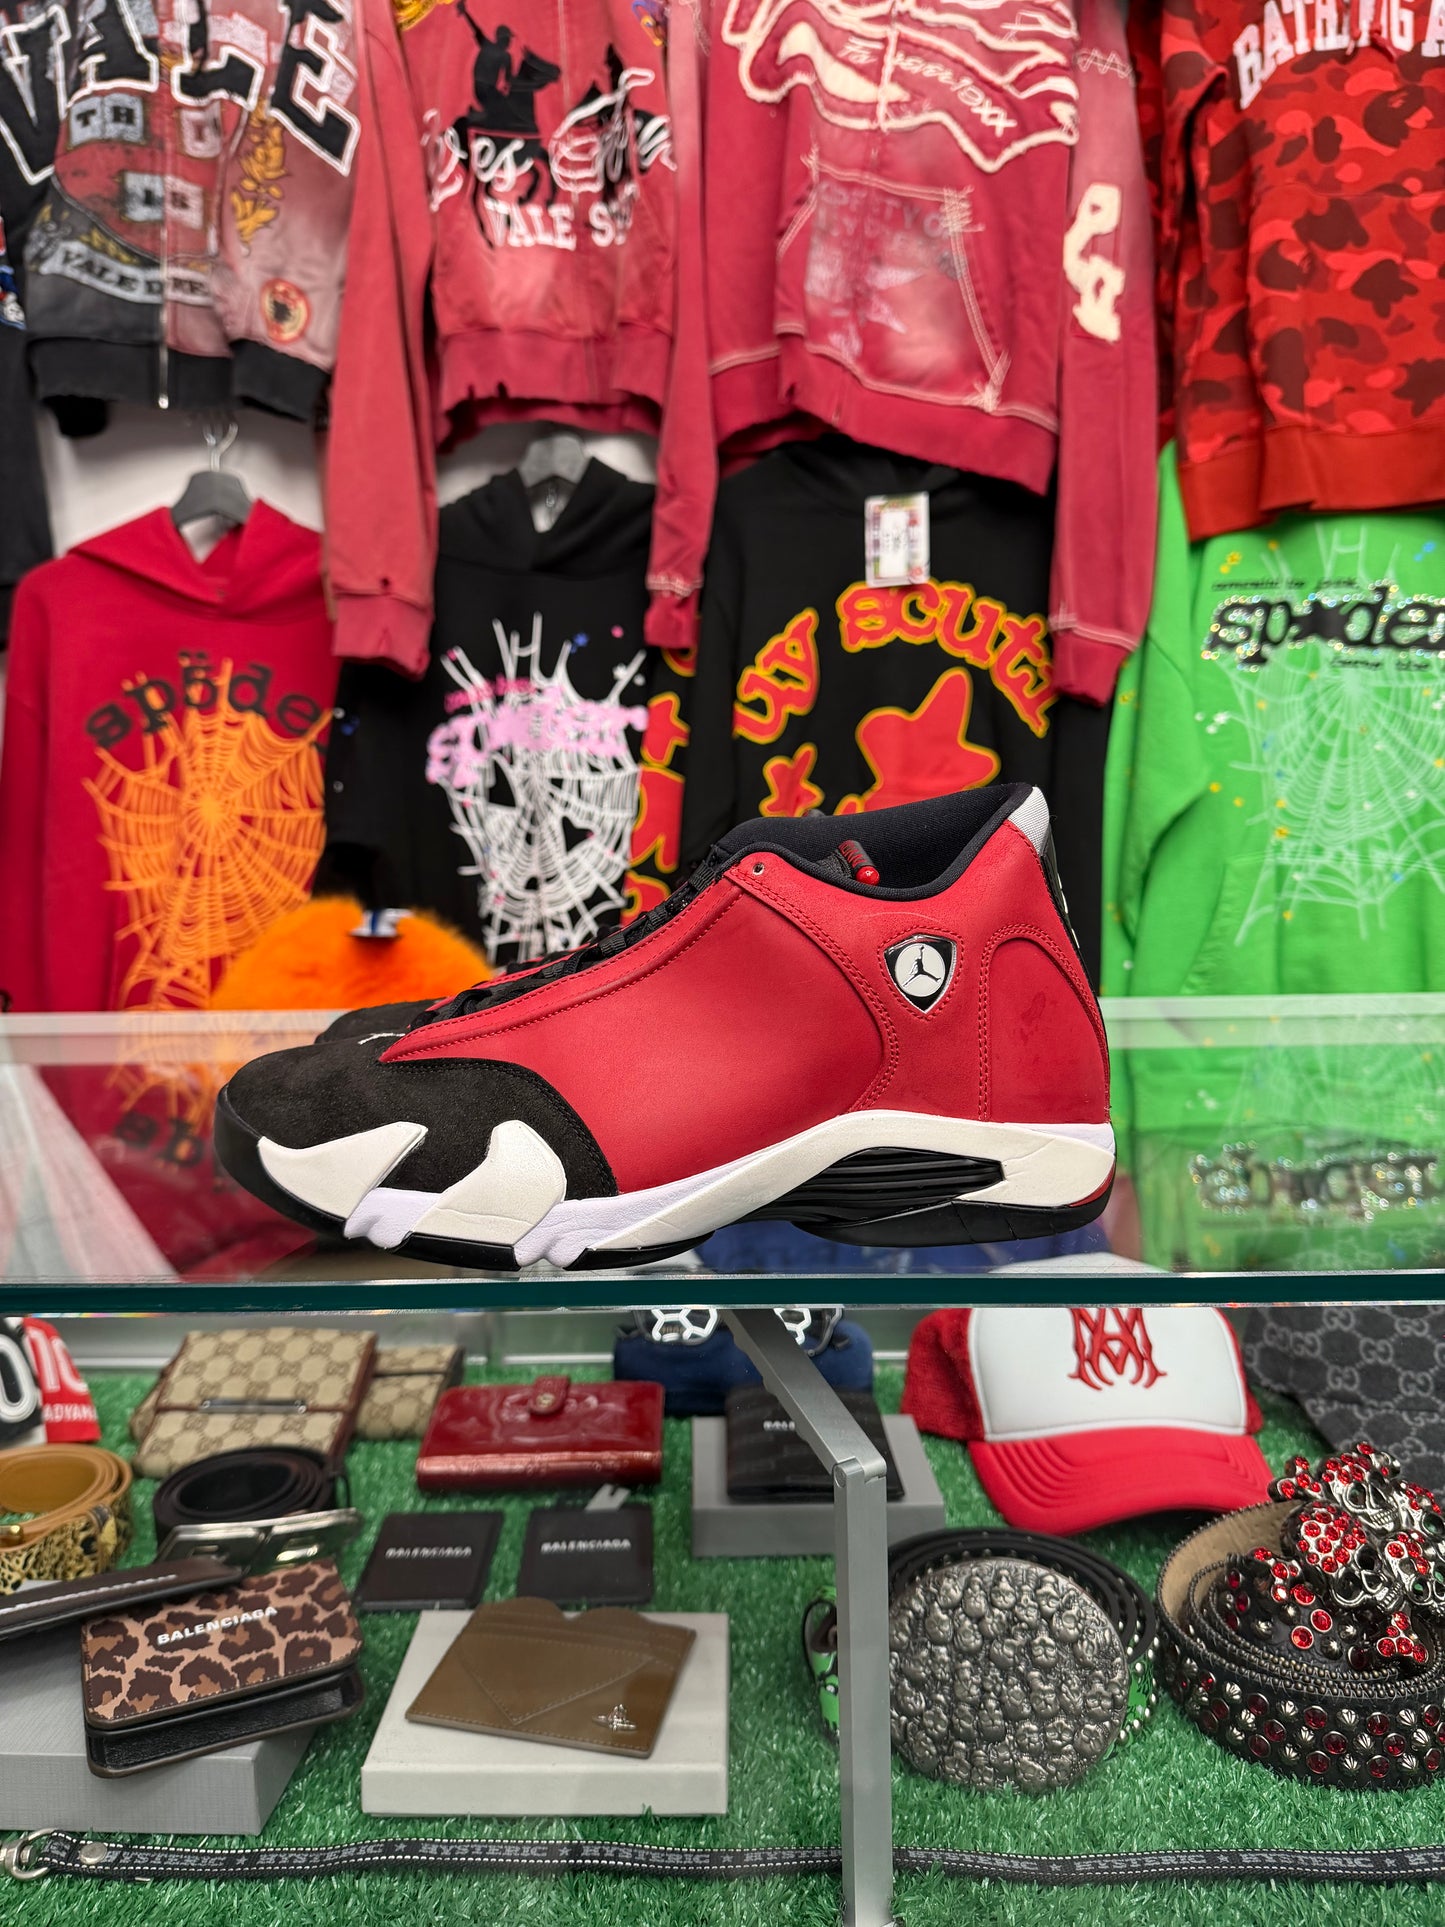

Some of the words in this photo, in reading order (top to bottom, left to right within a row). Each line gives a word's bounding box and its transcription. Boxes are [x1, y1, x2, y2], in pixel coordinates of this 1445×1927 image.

[482, 198, 577, 252] VALE
[156, 1605, 278, 1647] BALENCIAGA
[580, 1845, 710, 1864] HYSTERIC
